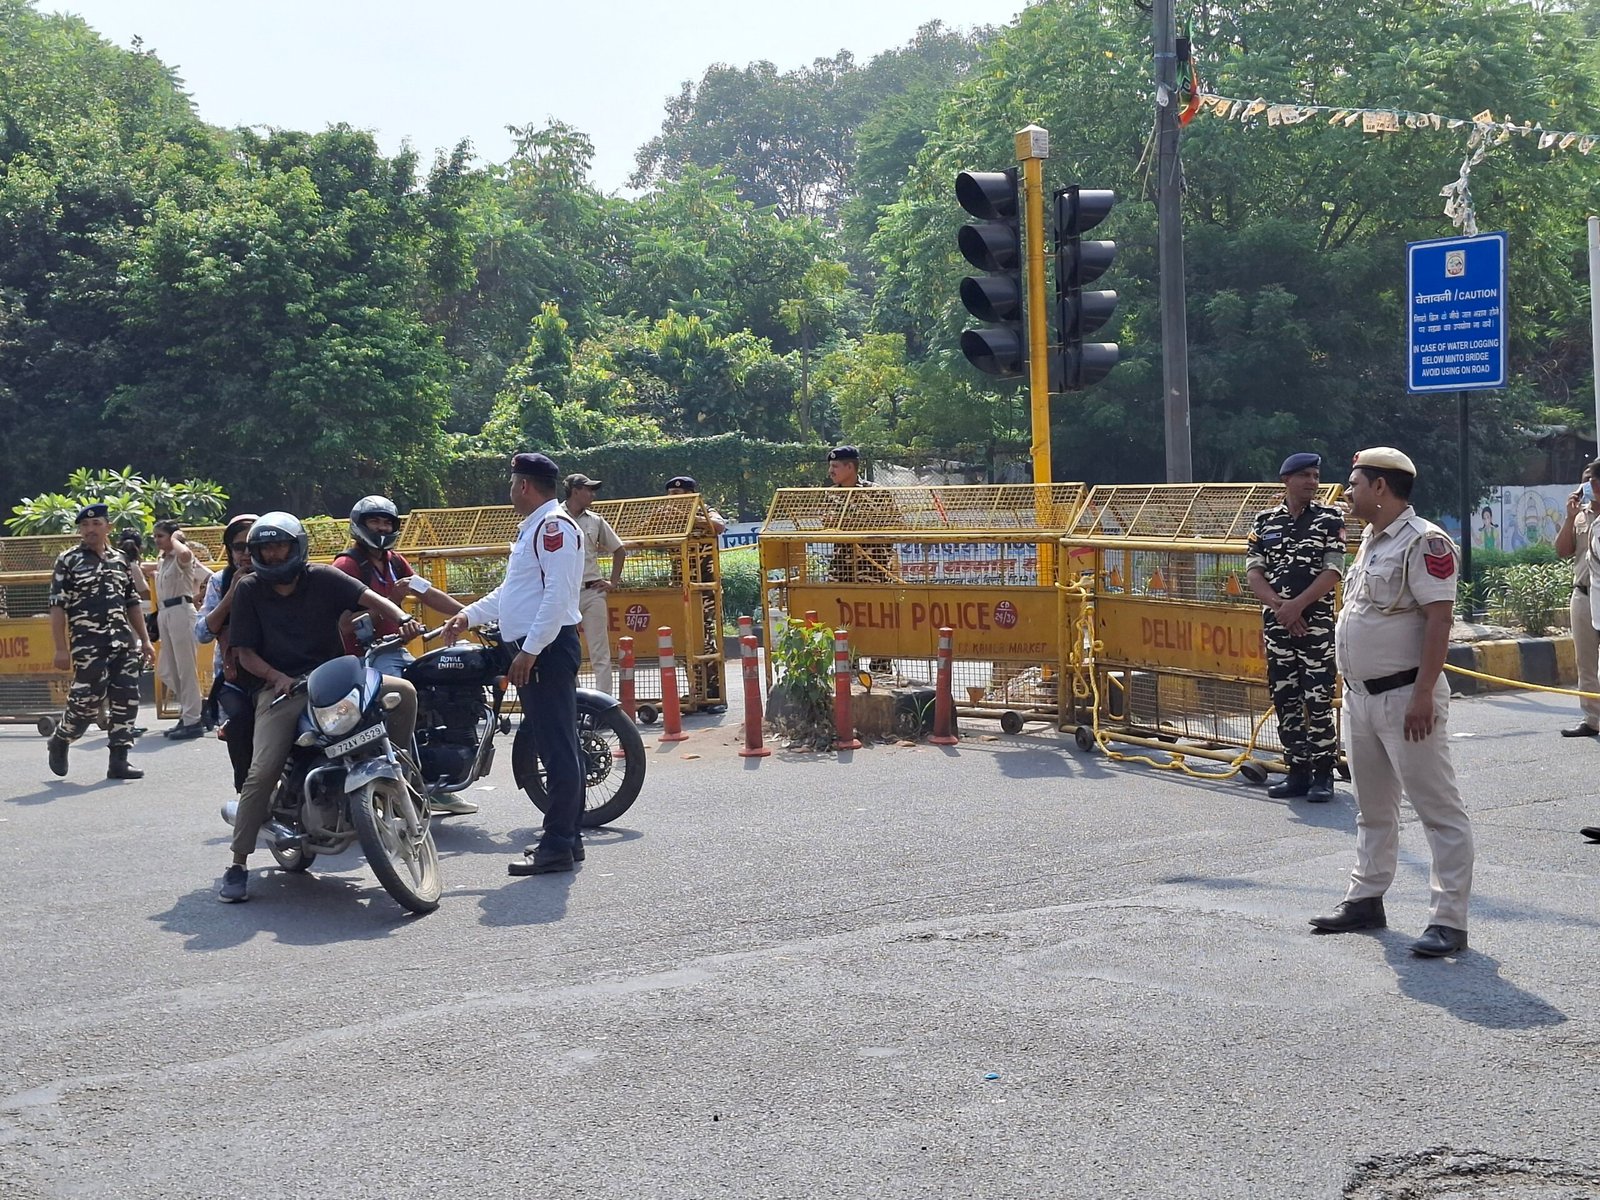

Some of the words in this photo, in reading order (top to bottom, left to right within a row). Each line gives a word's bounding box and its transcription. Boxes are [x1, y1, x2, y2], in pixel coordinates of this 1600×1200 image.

[1415, 289, 1451, 304] चेतावनी
[1413, 345, 1419, 353] IN
[1420, 343, 1437, 352] CASE
[1437, 342, 1446, 351] OF
[1447, 341, 1468, 351] WATER
[1469, 338, 1499, 349] LOGGING
[1422, 355, 1444, 365] BELOW
[1445, 353, 1464, 363] MINTO
[1465, 352, 1489, 362] BRIDGE
[1422, 368, 1440, 377] AVOID
[1441, 366, 1460, 376] USING
[1461, 365, 1471, 374] ON
[1471, 364, 1490, 373] ROAD
[629, 605, 642, 614] CD
[839, 602, 900, 629] DELHI
[912, 602, 991, 631] POLICE
[1141, 616, 1193, 651] DELHI
[1008, 642, 1047, 654] MARKET
[438, 662, 465, 670] ENFIELD
[360, 727, 381, 743] 3529
